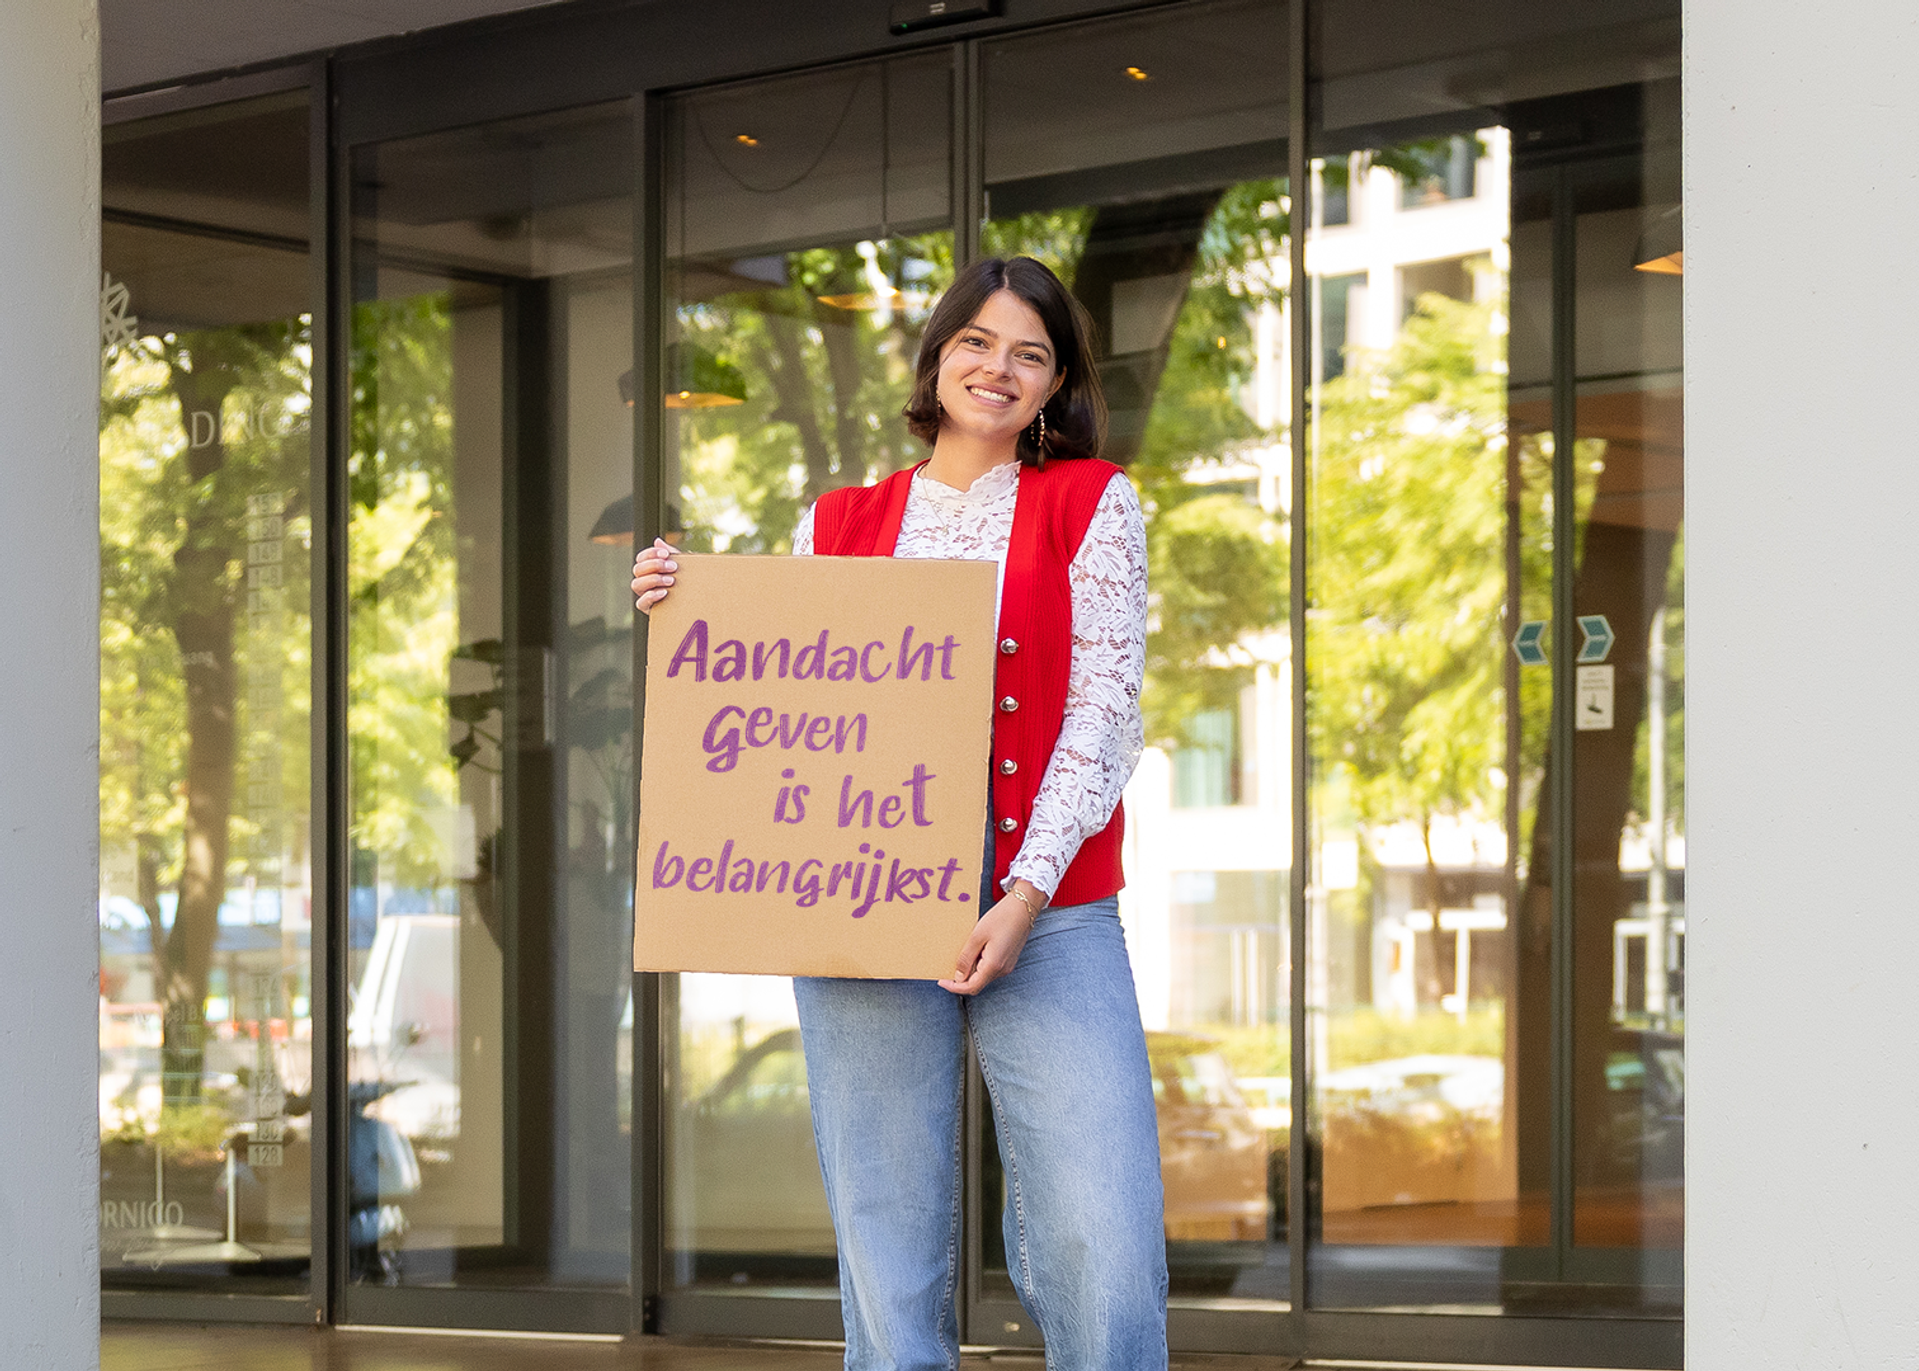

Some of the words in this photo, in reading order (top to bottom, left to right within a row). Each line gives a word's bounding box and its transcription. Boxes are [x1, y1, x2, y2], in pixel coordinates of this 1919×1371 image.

[667, 619, 961, 683] Aandacht
[702, 705, 868, 773] geven
[774, 768, 811, 824] is
[838, 763, 937, 828] het
[653, 839, 971, 918] belangrijkst.
